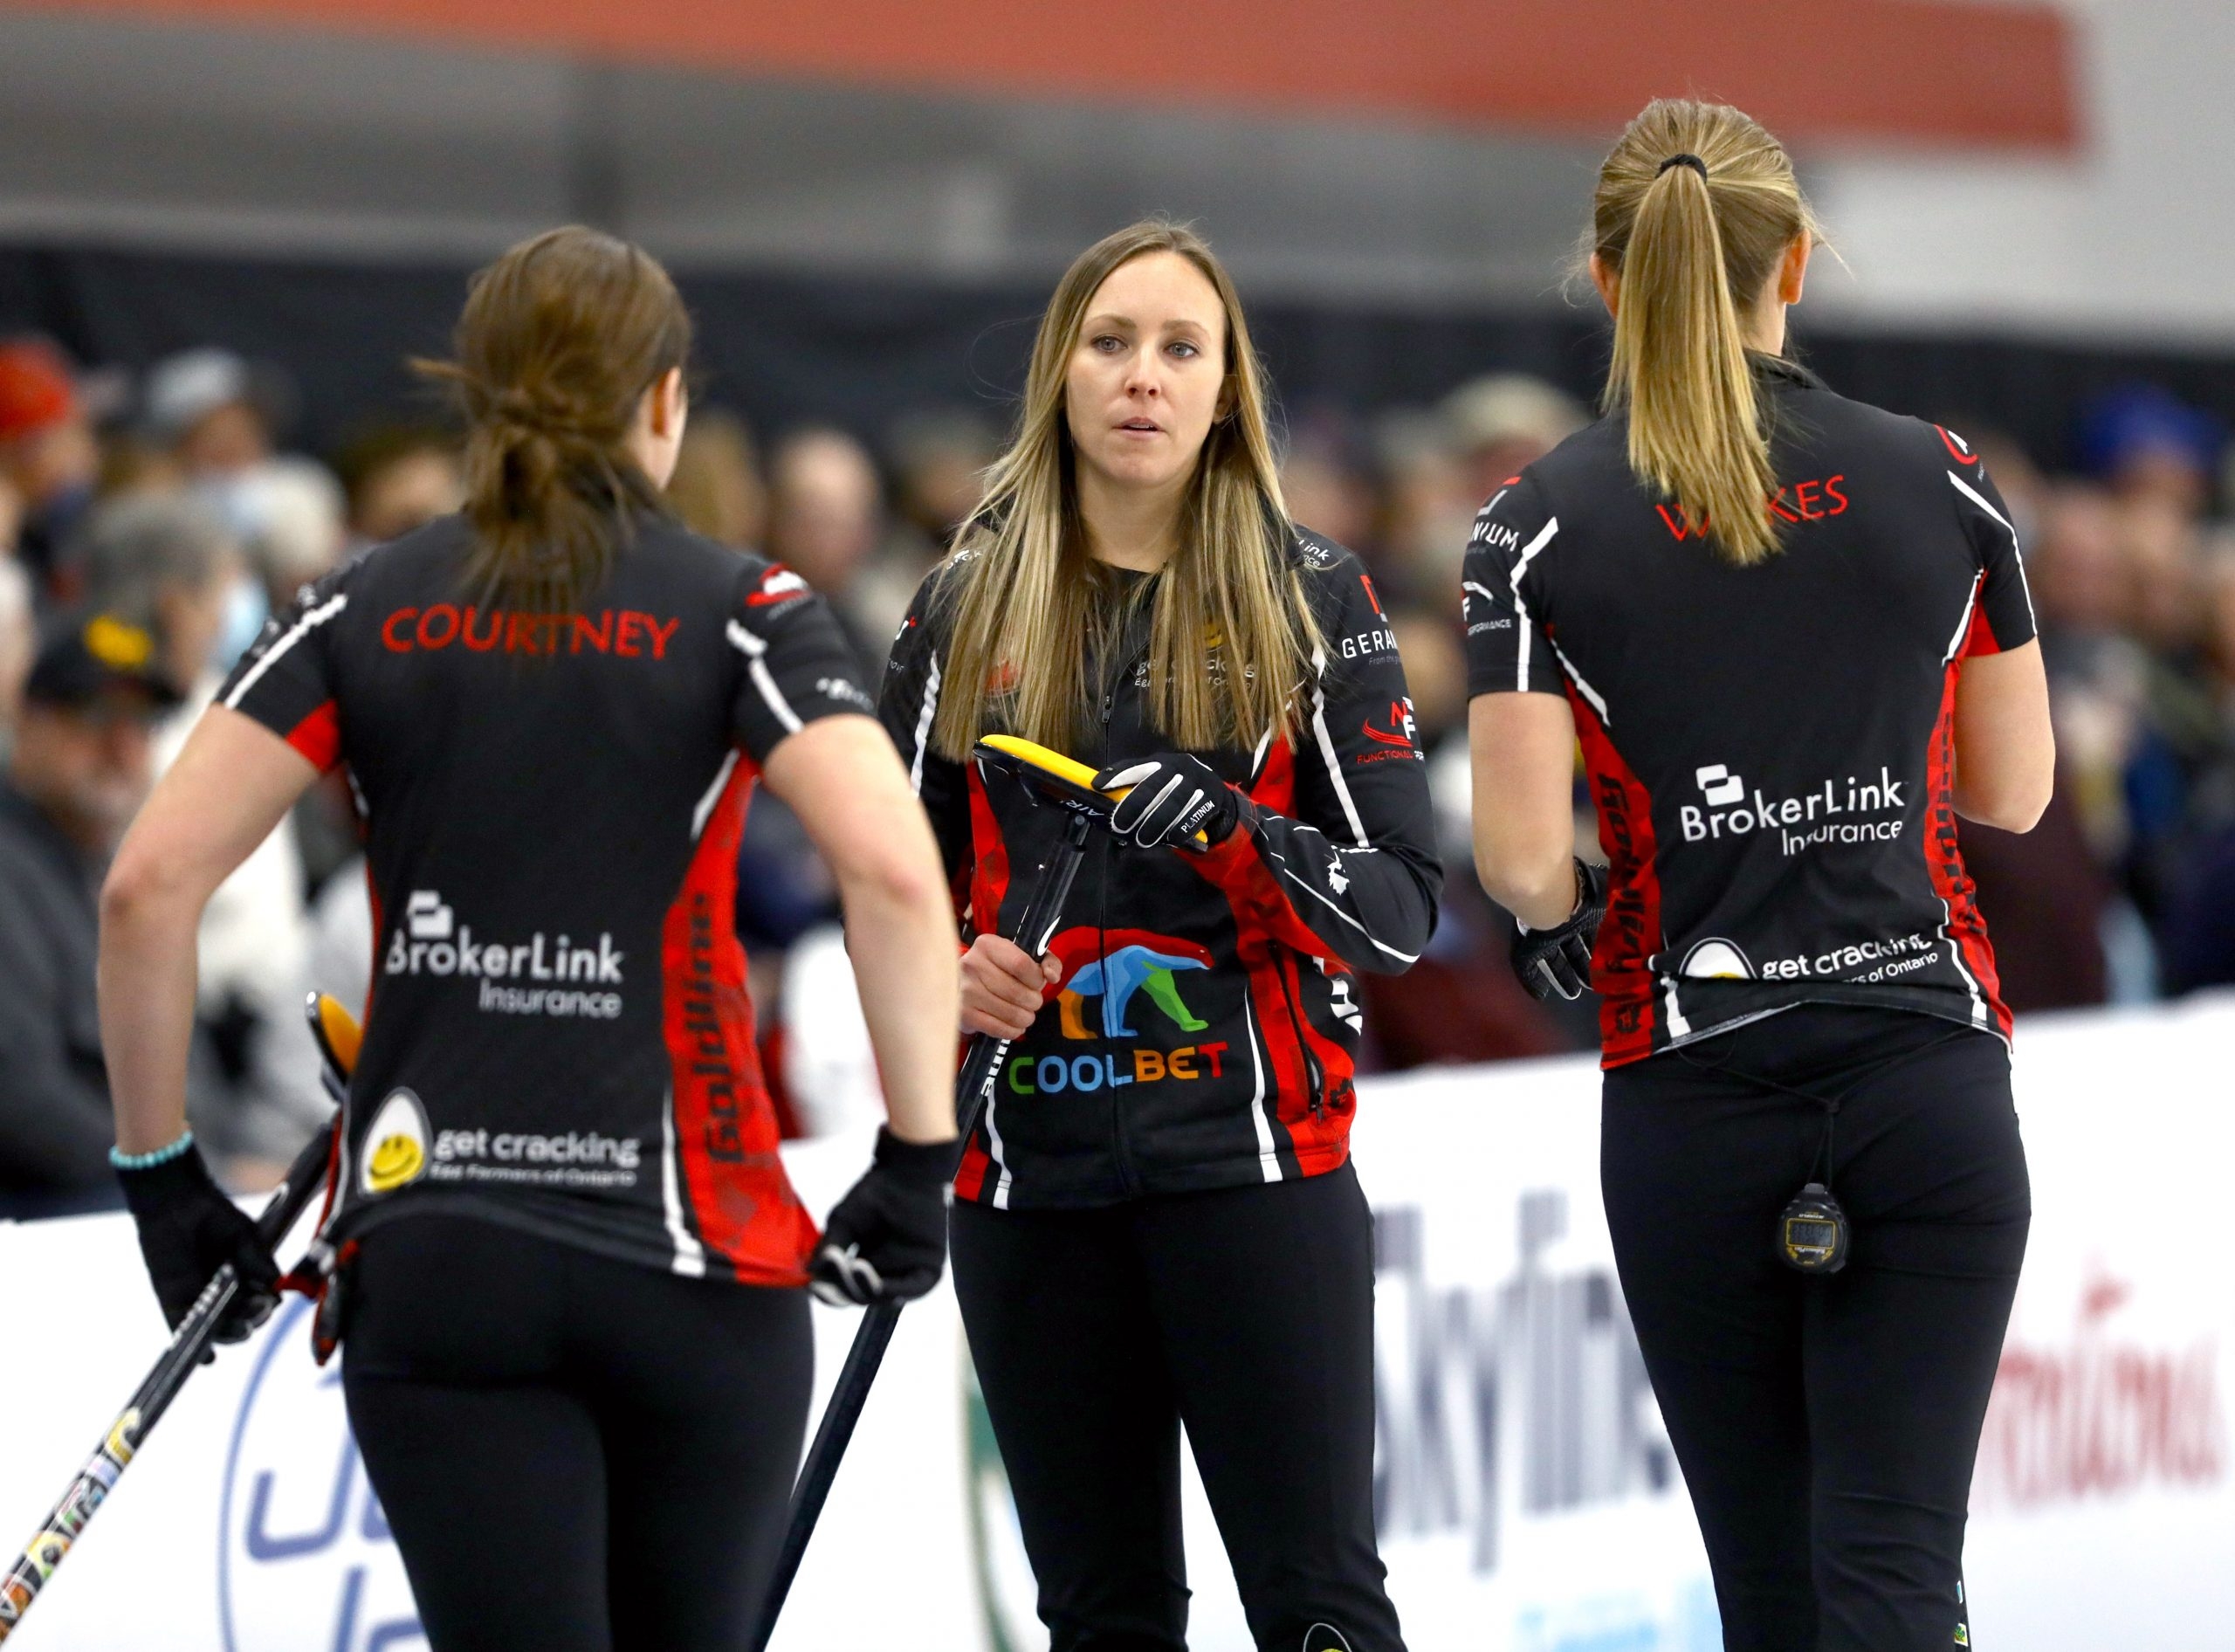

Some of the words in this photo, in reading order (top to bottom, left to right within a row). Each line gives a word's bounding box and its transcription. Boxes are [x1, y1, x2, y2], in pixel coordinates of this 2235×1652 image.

[1655, 474, 1848, 541] WKES
[381, 603, 681, 661] COURTNEY
[1179, 800, 1216, 834] PLATINUM
[1680, 766, 1906, 843] BrokerLink
[385, 925, 626, 983] BrokerLink
[1762, 954, 1811, 981] get
[1867, 966, 1884, 982] of
[1885, 952, 1939, 977] Ontario
[479, 977, 623, 1019] Insurance
[1008, 1042, 1228, 1095] COOLBET
[434, 1128, 489, 1162] get
[492, 1130, 641, 1169] cracking
